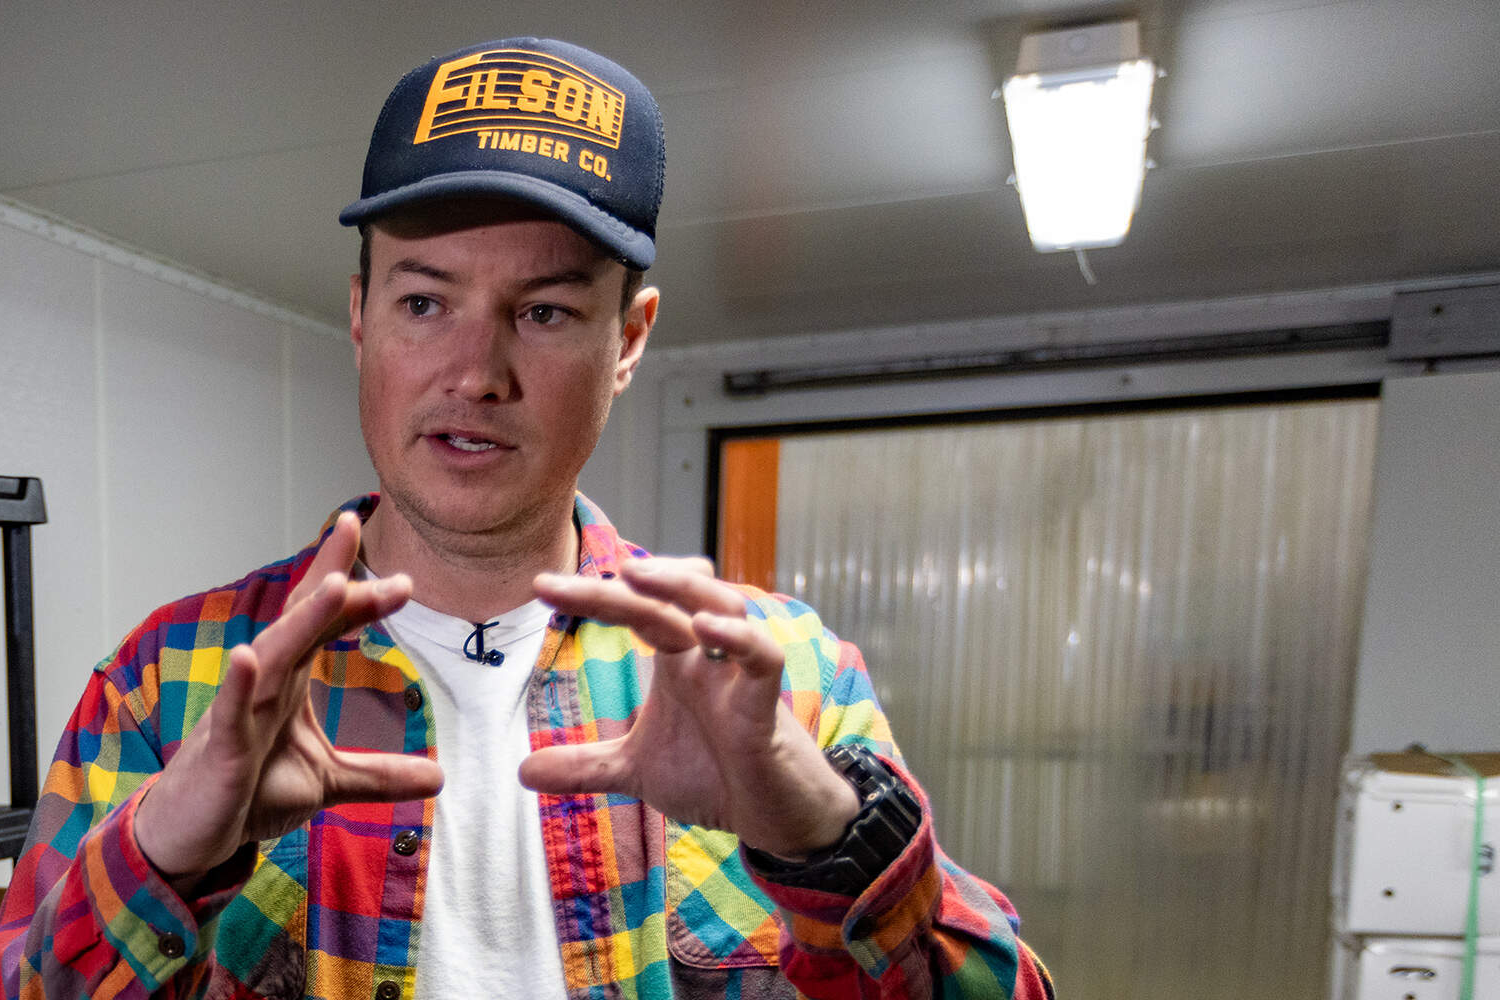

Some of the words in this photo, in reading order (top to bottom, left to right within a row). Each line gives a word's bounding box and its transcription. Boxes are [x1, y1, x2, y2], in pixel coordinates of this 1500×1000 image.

[413, 50, 620, 145] FILSON
[477, 131, 569, 163] TIMBER
[579, 149, 613, 182] CO.
